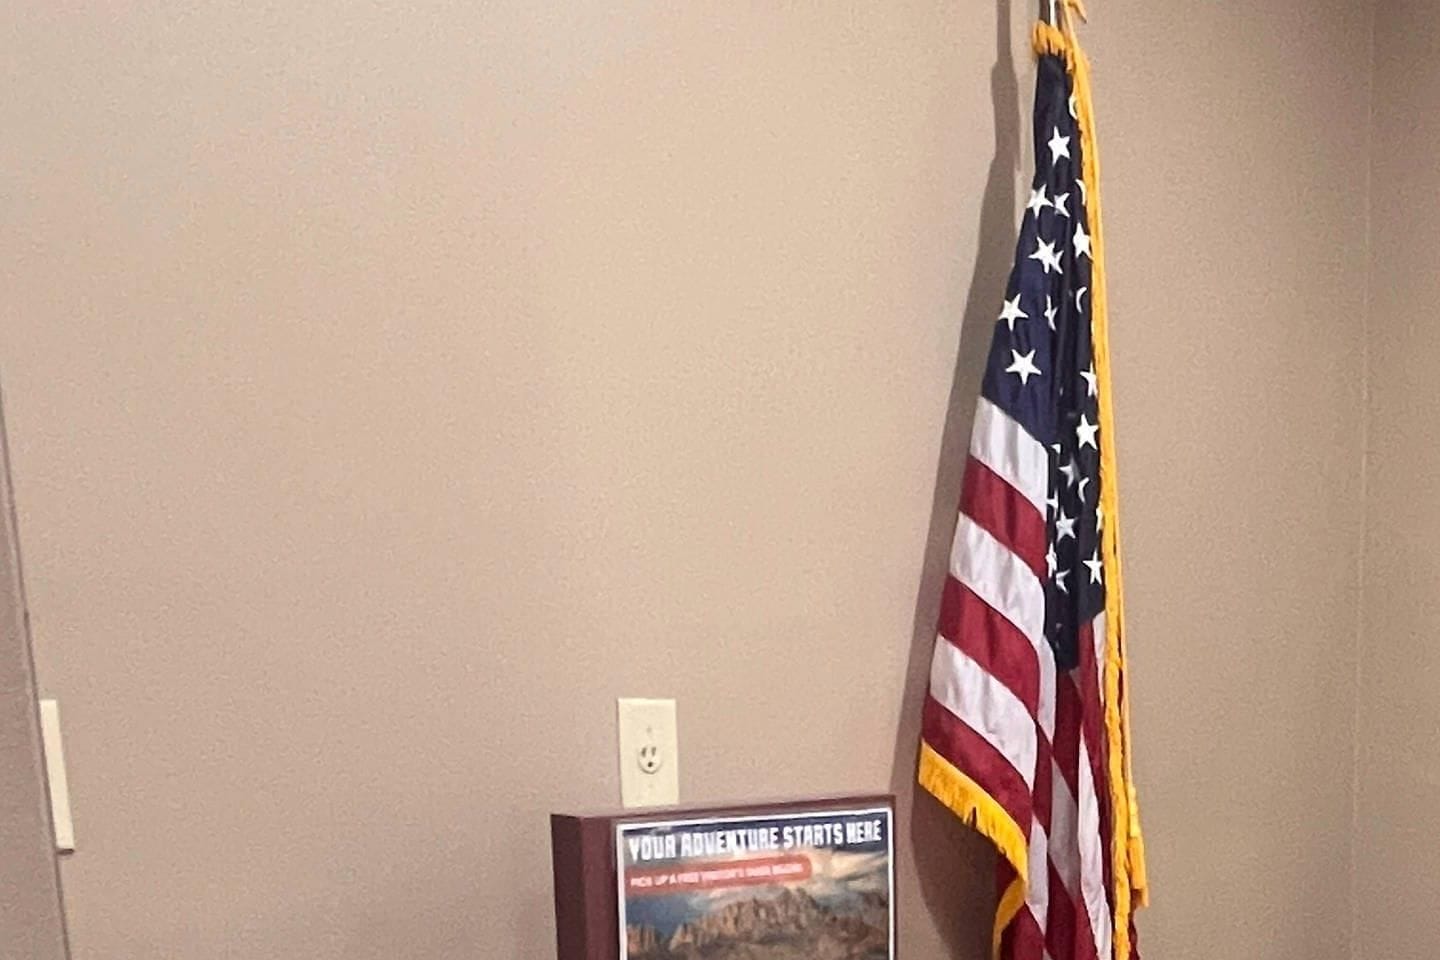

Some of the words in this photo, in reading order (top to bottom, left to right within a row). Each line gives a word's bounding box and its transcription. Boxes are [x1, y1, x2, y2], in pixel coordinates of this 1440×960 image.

[629, 834, 676, 862] YOUR
[680, 827, 779, 858] ADVENTURE
[782, 822, 844, 849] STARTS
[846, 819, 882, 844] HERE
